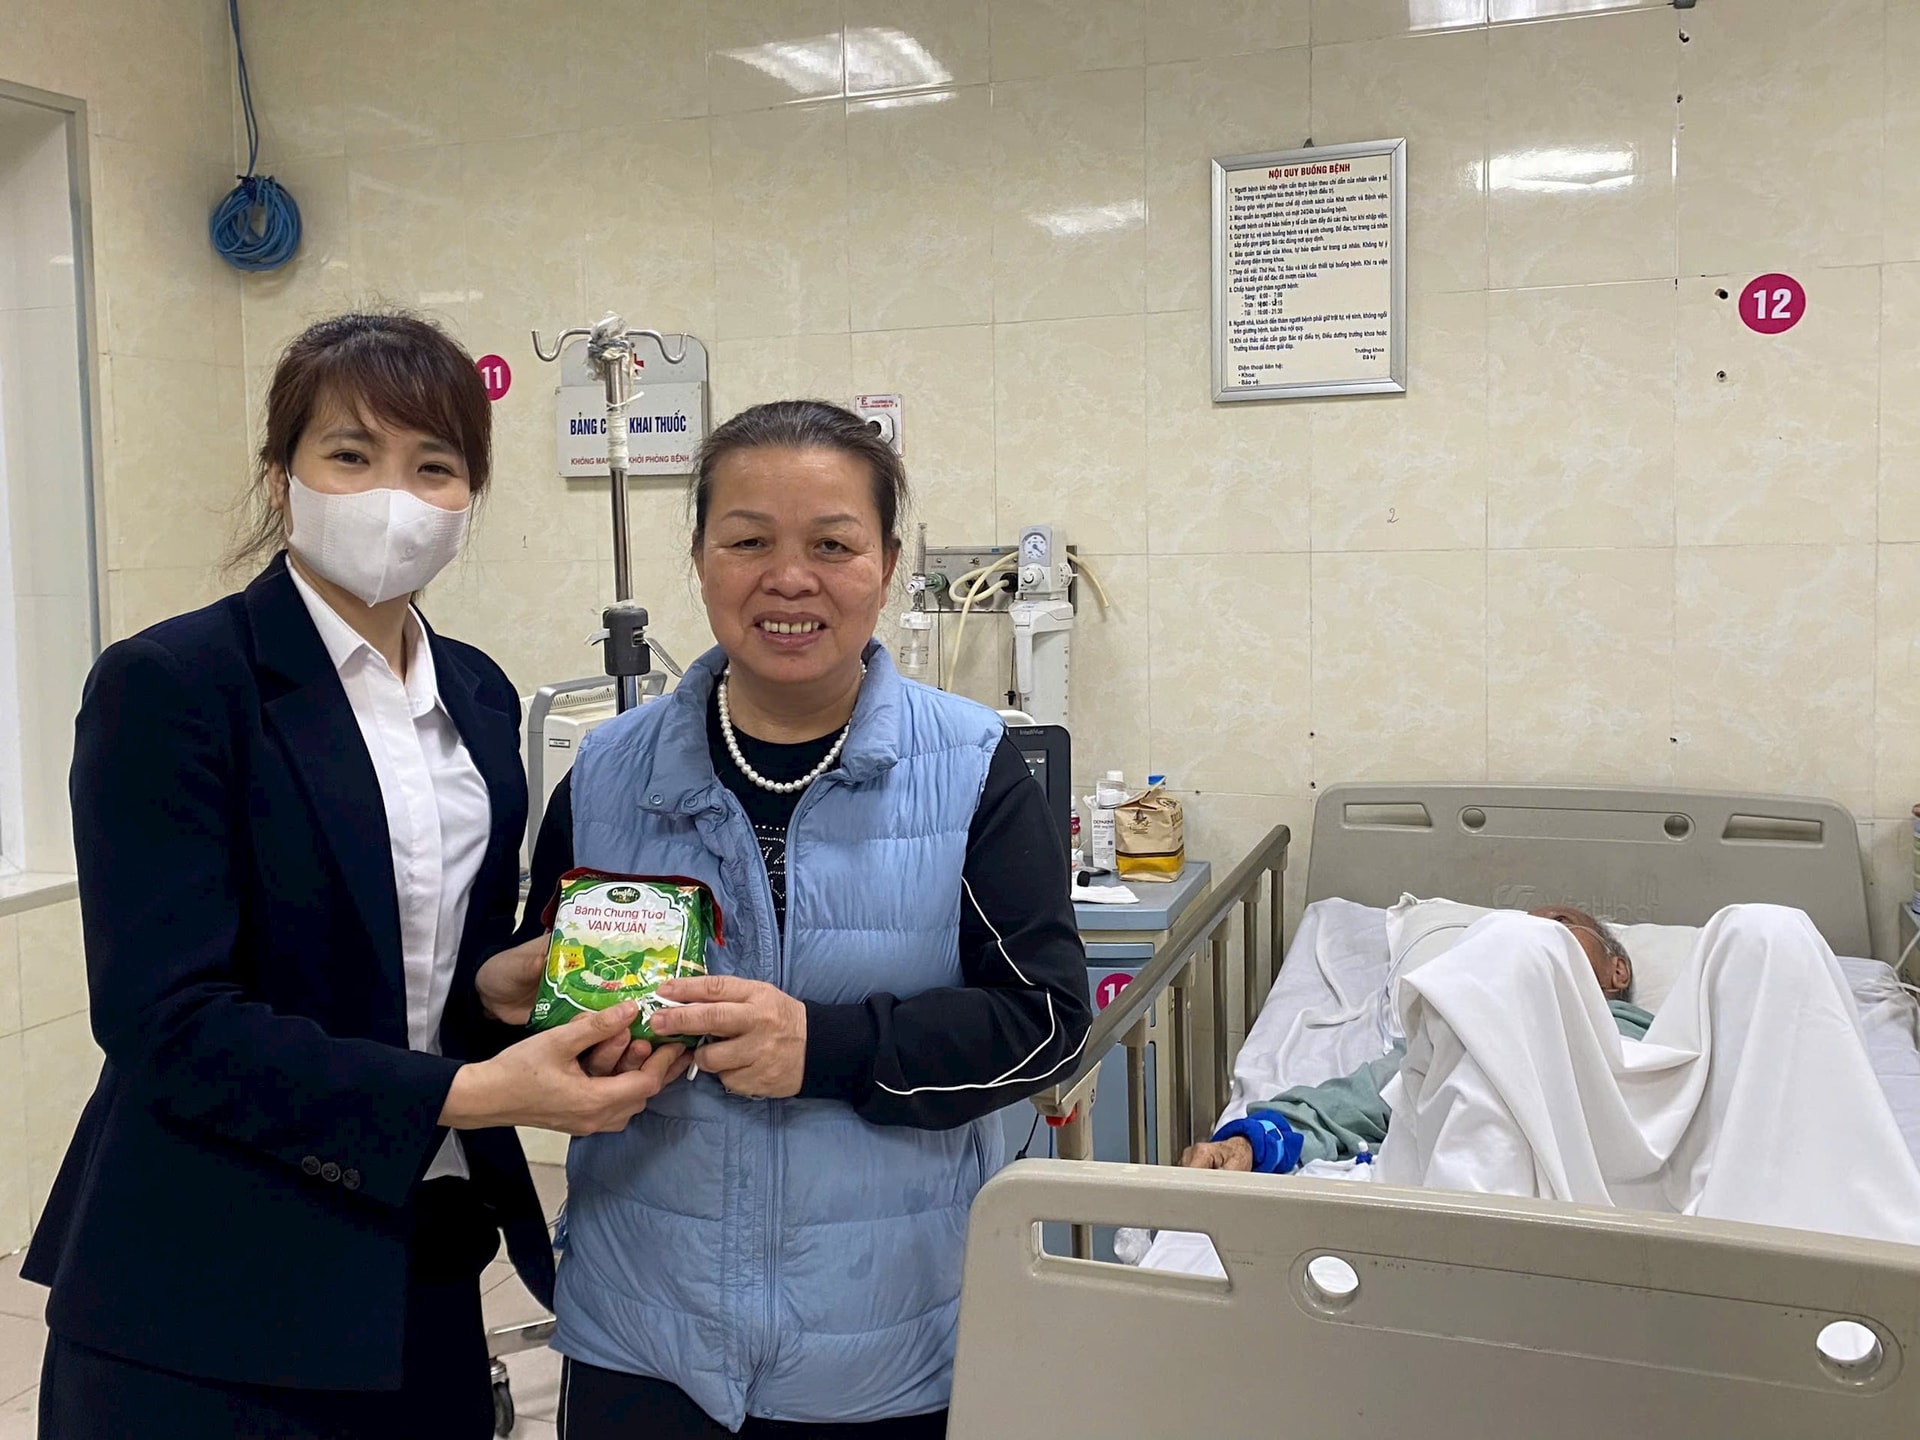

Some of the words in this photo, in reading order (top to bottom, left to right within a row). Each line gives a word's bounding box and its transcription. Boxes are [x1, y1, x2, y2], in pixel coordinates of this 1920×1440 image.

[1269, 168, 1282, 180] NỘI
[1284, 167, 1299, 178] QUY
[1330, 163, 1350, 174] BỆNH
[1753, 288, 1792, 319] 12
[482, 366, 502, 389] 11
[570, 411, 598, 435] BẢNG
[630, 416, 652, 434] KHAI
[655, 410, 686, 432] THUỐC
[1104, 984, 1128, 1004] 1
[534, 1002, 551, 1012] ISO
